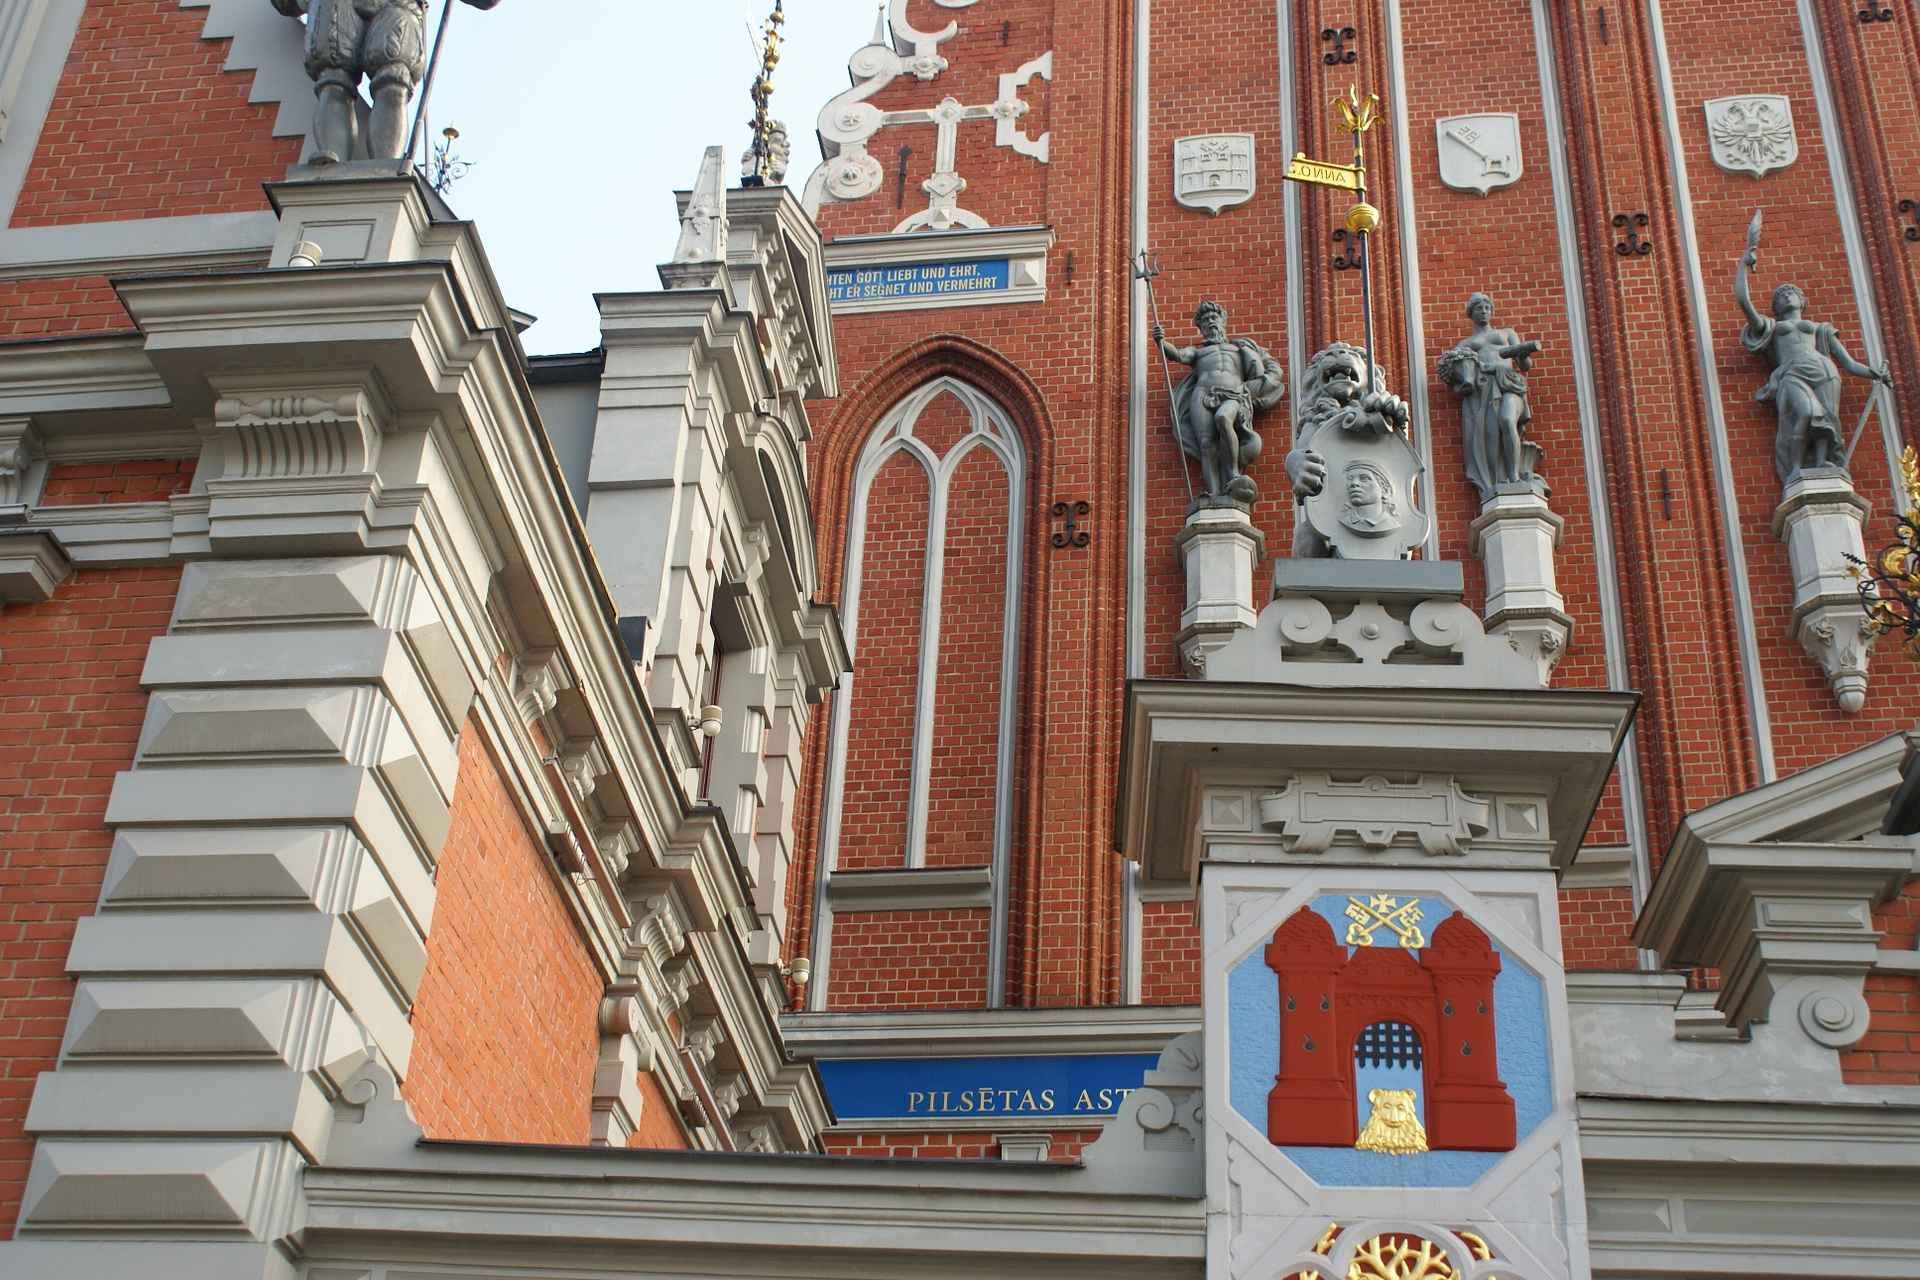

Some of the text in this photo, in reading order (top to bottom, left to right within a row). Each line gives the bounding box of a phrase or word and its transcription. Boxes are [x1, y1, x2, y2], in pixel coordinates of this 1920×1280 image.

[856, 271, 883, 284] GOTT
[887, 268, 918, 281] LIEBT
[921, 267, 946, 280] UND
[846, 285, 861, 298] ER
[864, 282, 906, 297] SEGNET
[909, 280, 934, 294] UND
[937, 276, 998, 292] VERMEHRT
[907, 1087, 1055, 1113] PILSĒTAS
